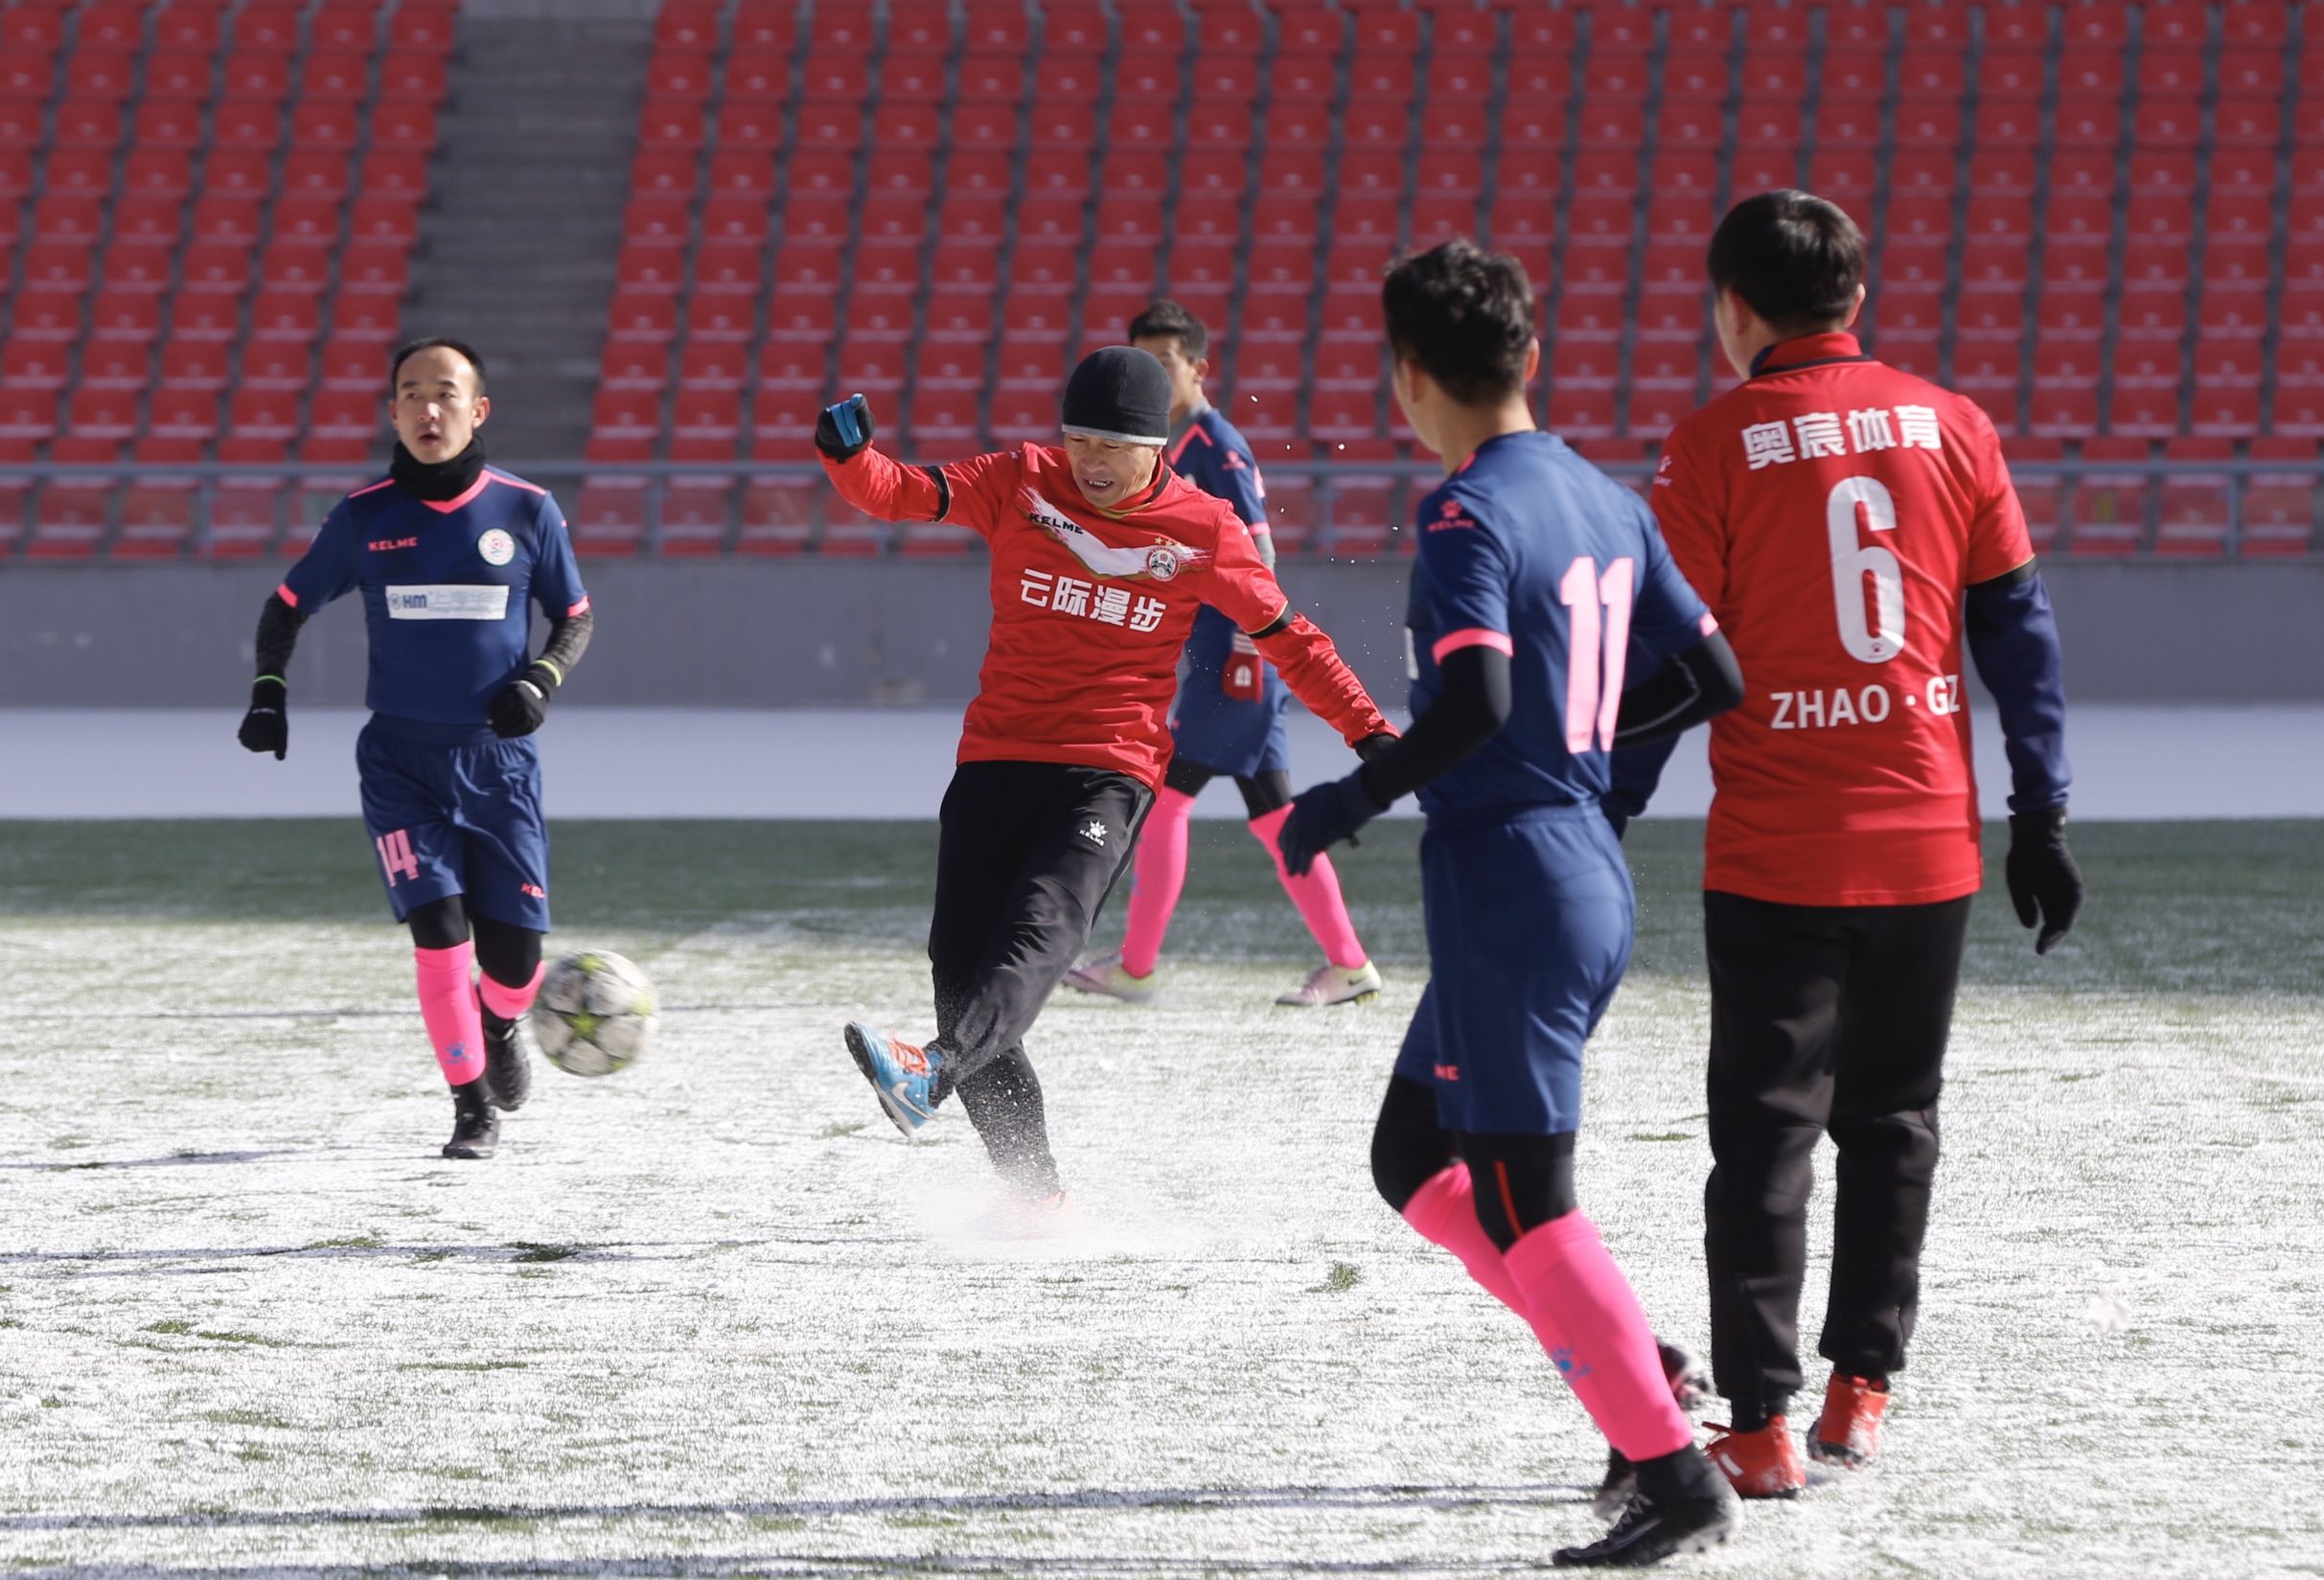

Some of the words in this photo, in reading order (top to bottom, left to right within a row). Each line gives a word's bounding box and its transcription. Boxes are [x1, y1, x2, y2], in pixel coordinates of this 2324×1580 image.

[1740, 404, 1942, 470] 奥宸体育
[368, 537, 419, 552] KELME
[1029, 513, 1084, 535] KELME
[1020, 568, 1166, 633] 云际漫步
[1826, 475, 1905, 664] 6
[1559, 556, 1634, 754] 11
[1770, 684, 1890, 729] ZHAO
[376, 829, 419, 888] 14
